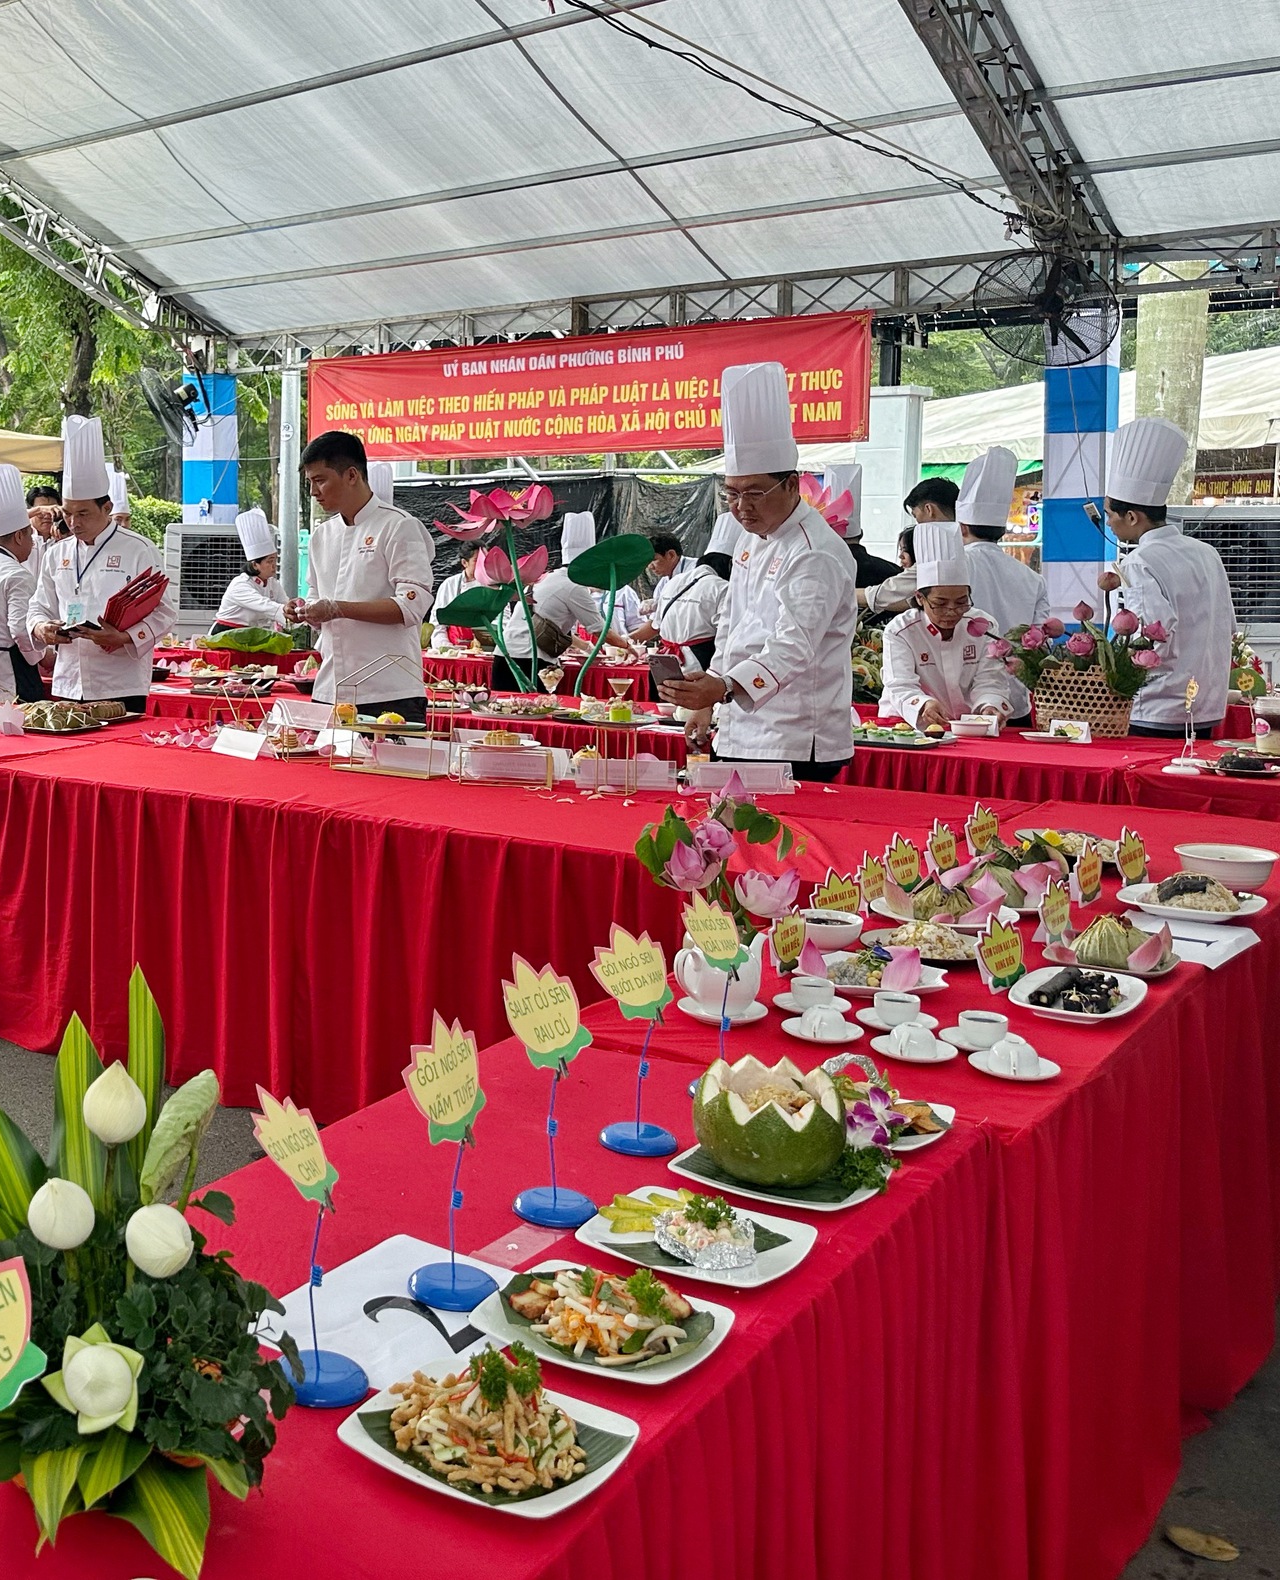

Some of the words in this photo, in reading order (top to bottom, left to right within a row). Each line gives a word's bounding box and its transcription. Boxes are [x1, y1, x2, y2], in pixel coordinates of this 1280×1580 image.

[462, 360, 486, 376] BAN
[490, 356, 526, 374] NHÂN
[529, 354, 556, 371] DÂN
[560, 348, 614, 368] PHƯỜNG
[618, 345, 651, 364] BÌNH
[656, 341, 684, 360] PHÚ
[801, 368, 843, 394] THỰC
[326, 398, 358, 421] SỐNG
[360, 398, 374, 418] VÀ
[377, 396, 403, 418] LÀM
[407, 397, 435, 419] VIỆC
[438, 396, 469, 414] THEO
[473, 385, 503, 412] HIẾN
[508, 388, 544, 410] PHÁP
[548, 385, 566, 407] VÀ
[571, 381, 608, 405] PHÁP
[613, 380, 648, 406] LUẬT
[652, 378, 670, 401] LÀ
[674, 376, 708, 402] VIỆC
[803, 401, 842, 422] NAM
[368, 425, 393, 445] ỨNG
[396, 422, 429, 443] NGÀY
[431, 420, 466, 441] PHÁP
[469, 418, 500, 442] LUẬT
[503, 415, 541, 438] NƯỚC
[545, 413, 583, 440] CỘNG
[587, 410, 616, 434] HÒA
[621, 408, 642, 432] XÃ
[645, 407, 670, 434] HỘI
[674, 403, 706, 429] CHỦ
[1255, 480, 1271, 493] ANH
[848, 889, 856, 899] SEN
[717, 918, 730, 930] SEN
[602, 961, 619, 976] GỎI
[619, 952, 639, 971] NGÓ
[640, 951, 654, 965] SEN
[635, 975, 649, 988] DA
[647, 969, 663, 984] XANH
[509, 996, 534, 1019] SALAT
[534, 987, 549, 1010] CỦ
[549, 985, 570, 1005] SEN
[534, 1022, 555, 1043] RAU
[555, 1013, 570, 1036] CỦ
[417, 1059, 439, 1086] GỎI
[440, 1045, 458, 1075] NGÓ
[457, 1040, 472, 1063] SEN
[268, 1136, 288, 1161] GỎI
[282, 1127, 304, 1156] NGÓ
[299, 1127, 318, 1147] SEN
[298, 1157, 322, 1181] CHAY
